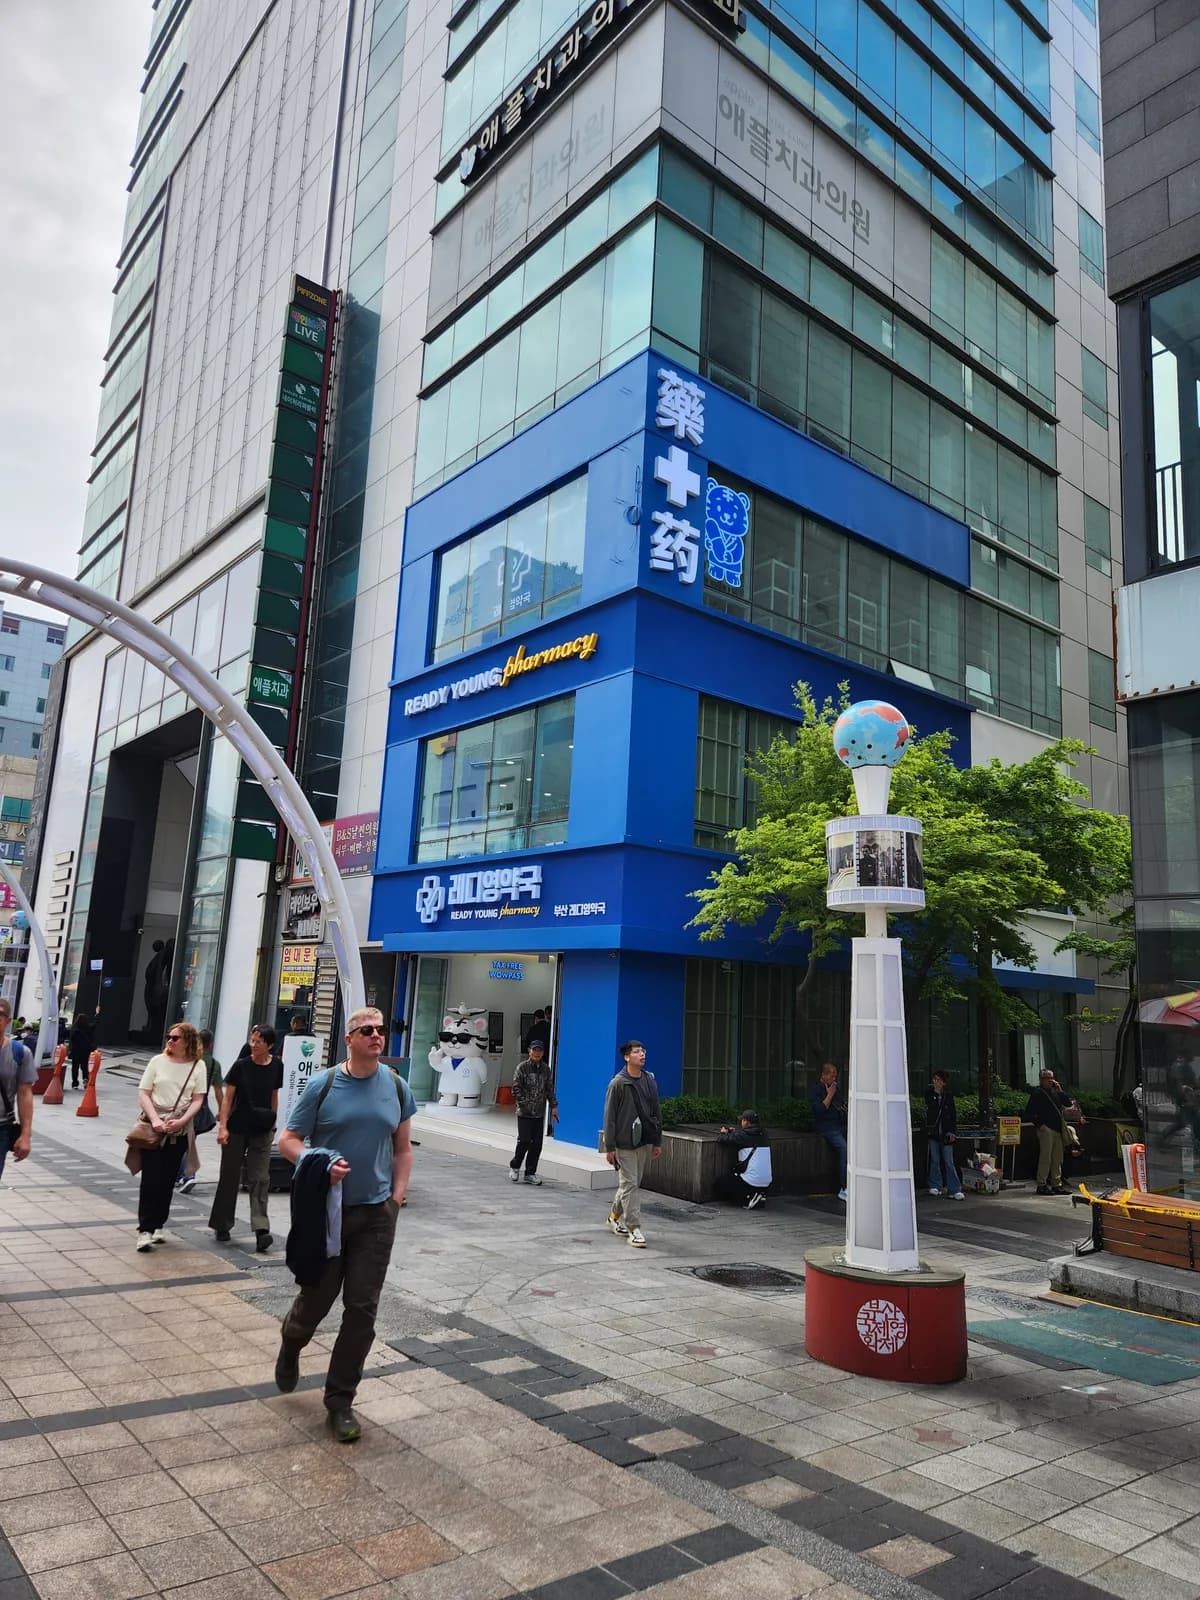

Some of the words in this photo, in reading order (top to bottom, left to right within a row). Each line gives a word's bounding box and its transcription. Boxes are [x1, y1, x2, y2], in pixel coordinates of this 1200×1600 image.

[480, 0, 635, 150] 애플치과의
[718, 92, 871, 246] 애플치과의원
[295, 323, 319, 343] LIVE
[655, 367, 706, 447] 藥
[649, 511, 701, 584] 药
[252, 676, 290, 699] 애플치과
[404, 686, 450, 716] READY
[449, 667, 502, 700] YOUNG
[501, 632, 599, 687] pharmacy
[448, 864, 543, 905] 레디영약국
[450, 910, 473, 920] READY
[474, 908, 498, 919] YOUNG
[498, 902, 541, 920] pharmacy
[553, 904, 568, 917] 부산
[568, 902, 606, 916] 레디영약국
[493, 960, 506, 969] TAX
[507, 962, 524, 970] FREE
